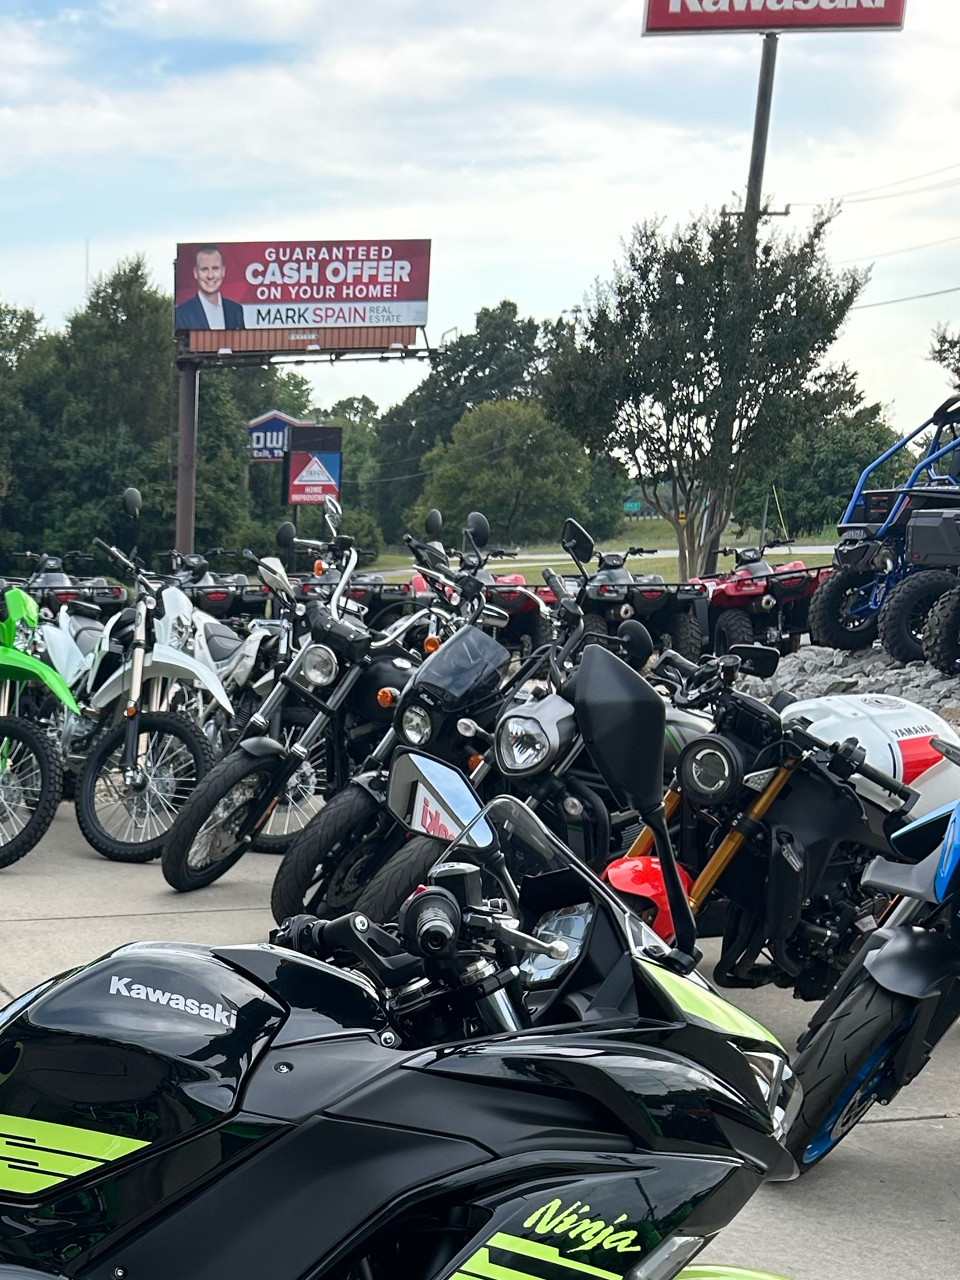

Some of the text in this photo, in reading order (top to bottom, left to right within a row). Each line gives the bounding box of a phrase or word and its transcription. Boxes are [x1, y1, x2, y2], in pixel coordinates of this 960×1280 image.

[265, 246, 393, 261] GUARANTEED
[245, 260, 411, 285] CASH OFFER
[256, 284, 398, 300] ON YOUR HOME!
[256, 305, 392, 325] MARK SPAIN REAL
[369, 314, 402, 324] ESTATE
[890, 724, 934, 738] YAMAHA
[109, 975, 238, 1029] Kawasaki
[523, 1198, 641, 1253] Ninja
